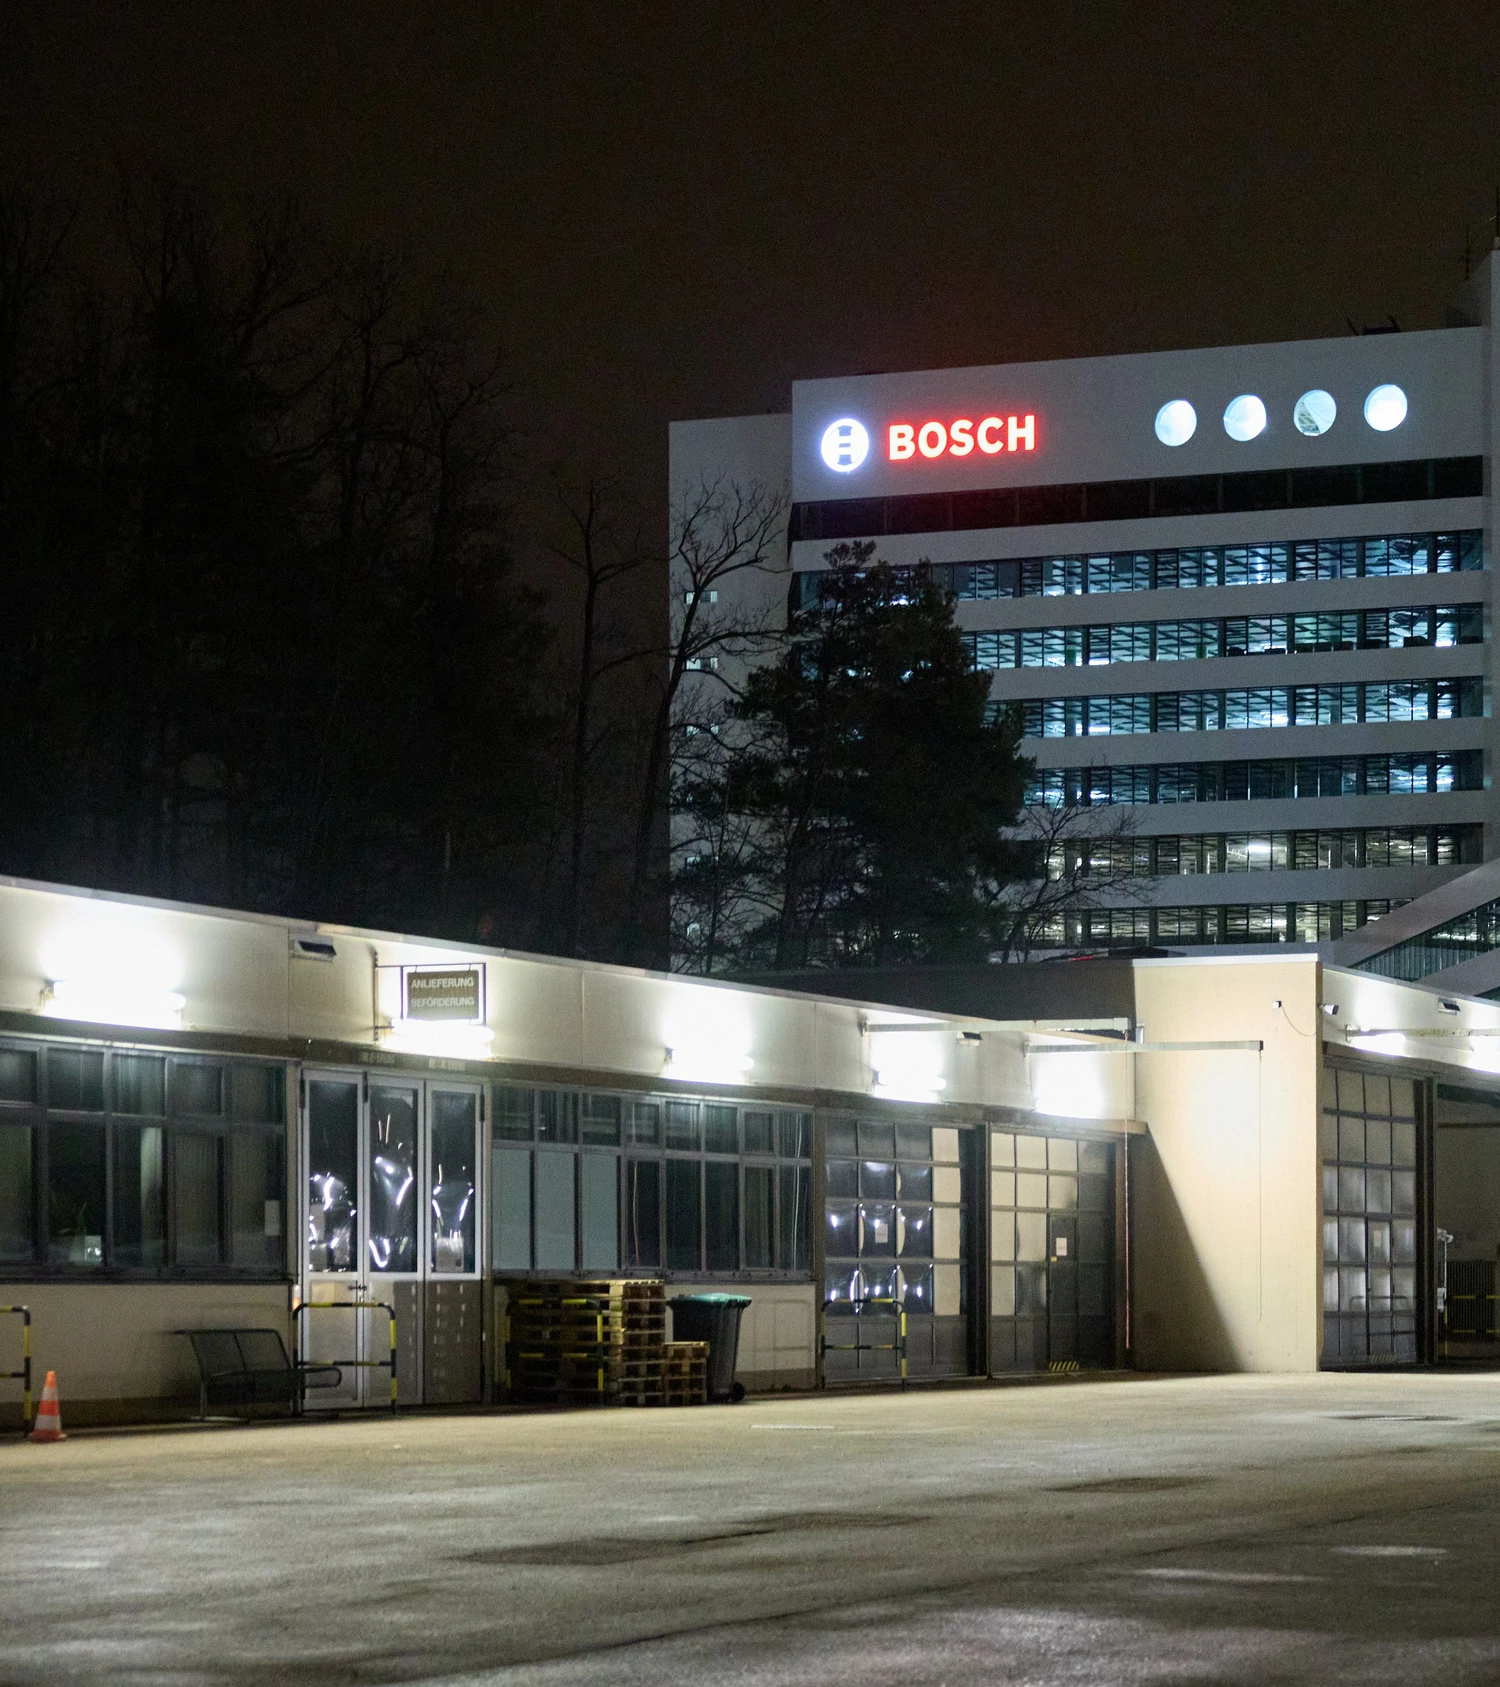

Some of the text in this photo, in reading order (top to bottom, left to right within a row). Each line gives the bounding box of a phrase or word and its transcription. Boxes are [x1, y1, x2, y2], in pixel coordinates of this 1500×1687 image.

[889, 415, 1035, 460] BOSCH
[411, 976, 474, 989] ANLIEFERUNG
[411, 996, 474, 1007] BEFÖRDERUNG
